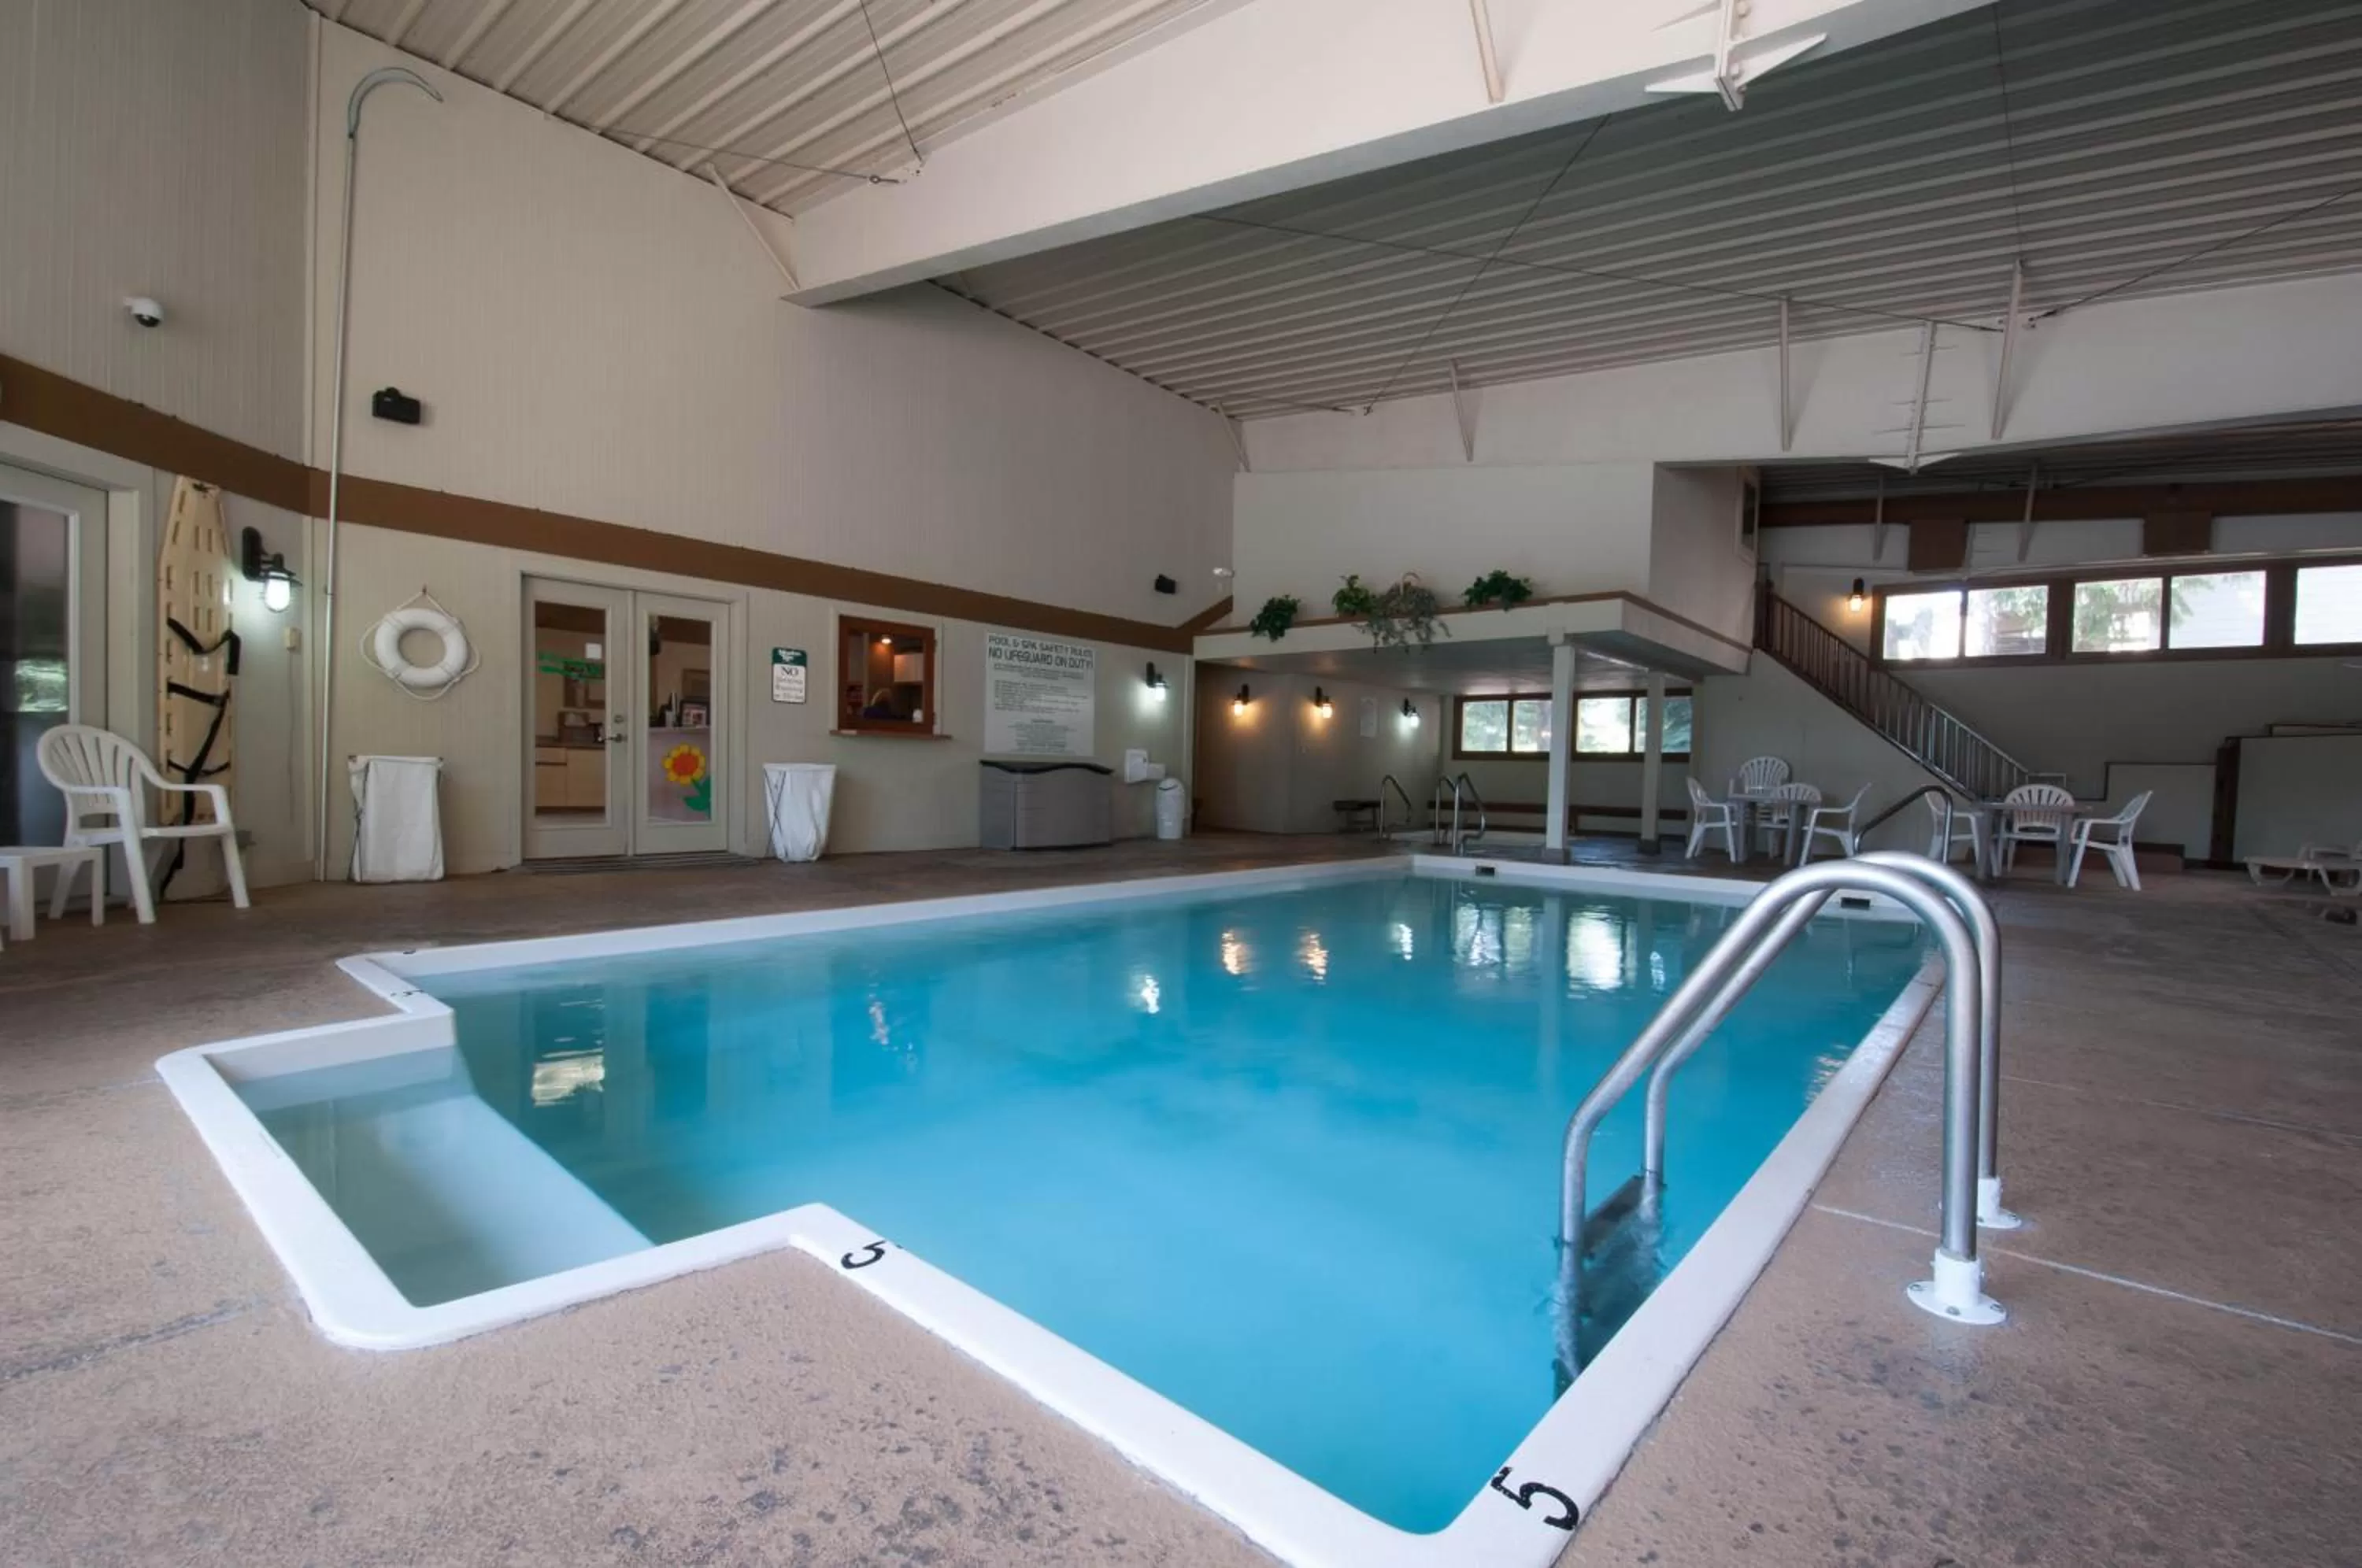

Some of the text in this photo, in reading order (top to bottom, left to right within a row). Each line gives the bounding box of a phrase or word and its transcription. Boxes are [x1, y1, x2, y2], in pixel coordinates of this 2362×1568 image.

[989, 647, 1002, 658] NO
[1005, 649, 1053, 664] LIFEGUARD
[1055, 656, 1067, 668] ON
[781, 666, 799, 676] NO
[840, 1240, 903, 1270] 5
[1490, 1466, 1579, 1530] 5
